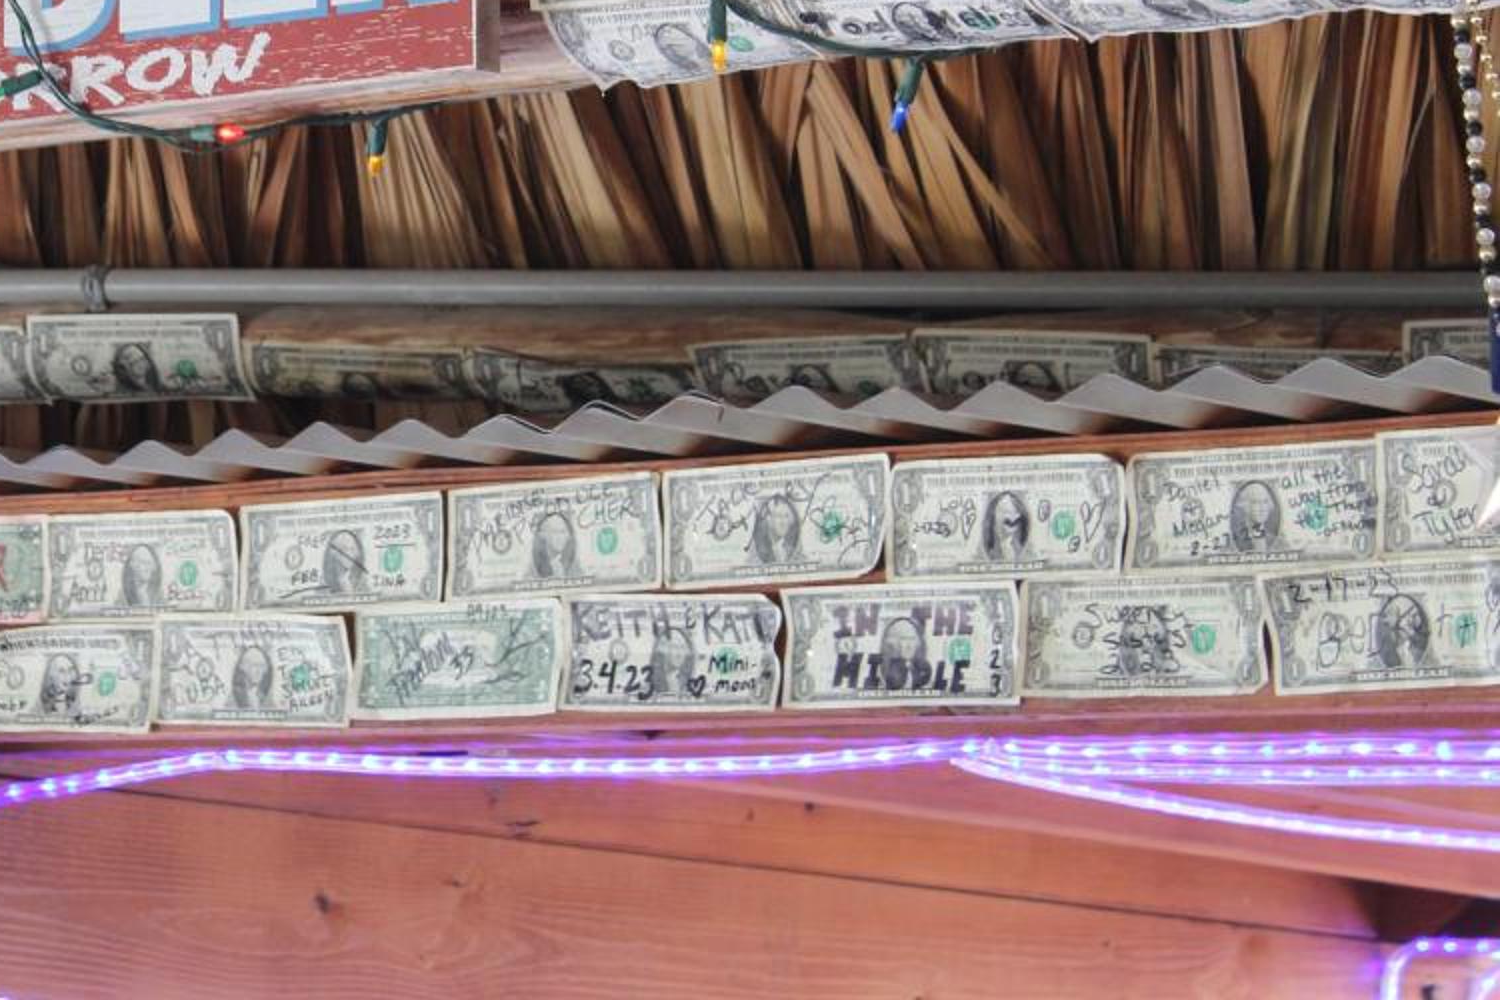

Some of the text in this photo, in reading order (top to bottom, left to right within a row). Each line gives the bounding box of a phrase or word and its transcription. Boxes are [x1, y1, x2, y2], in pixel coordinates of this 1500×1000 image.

[832, 601, 977, 639] IN THE
[573, 658, 655, 701] 3.4.23
[832, 652, 972, 694] MIDDLE
